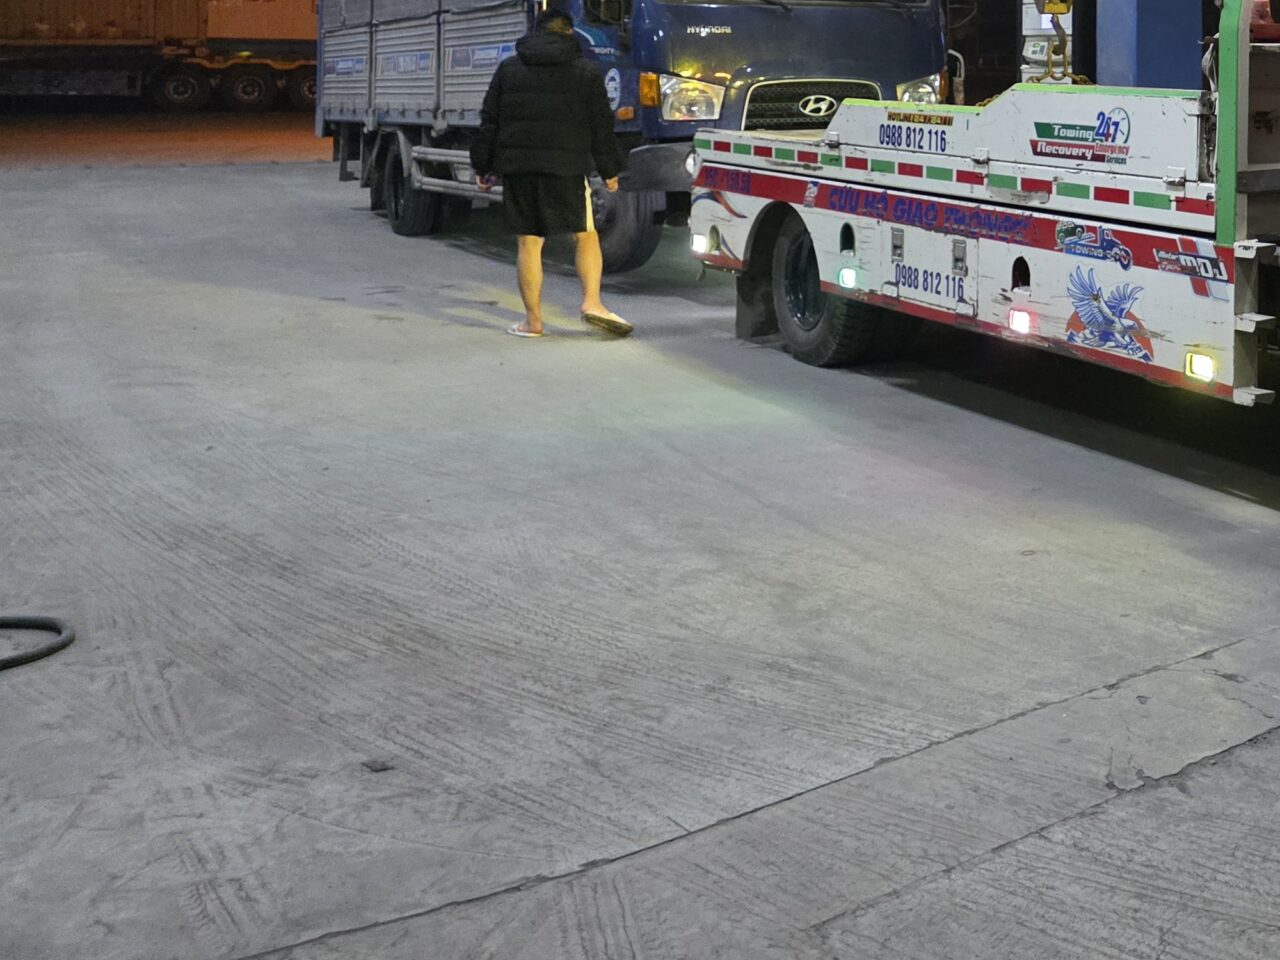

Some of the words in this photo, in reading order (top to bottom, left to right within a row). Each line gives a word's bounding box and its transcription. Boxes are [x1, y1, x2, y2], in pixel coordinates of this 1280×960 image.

[879, 123, 903, 148] 0988
[905, 126, 925, 150] 812
[927, 128, 947, 153] 116
[1052, 124, 1094, 142] Towing
[1036, 141, 1094, 160] Recovery
[1070, 244, 1104, 257] TOWING
[895, 262, 919, 289] 0988
[922, 269, 941, 295] 812
[945, 274, 965, 301] 116
